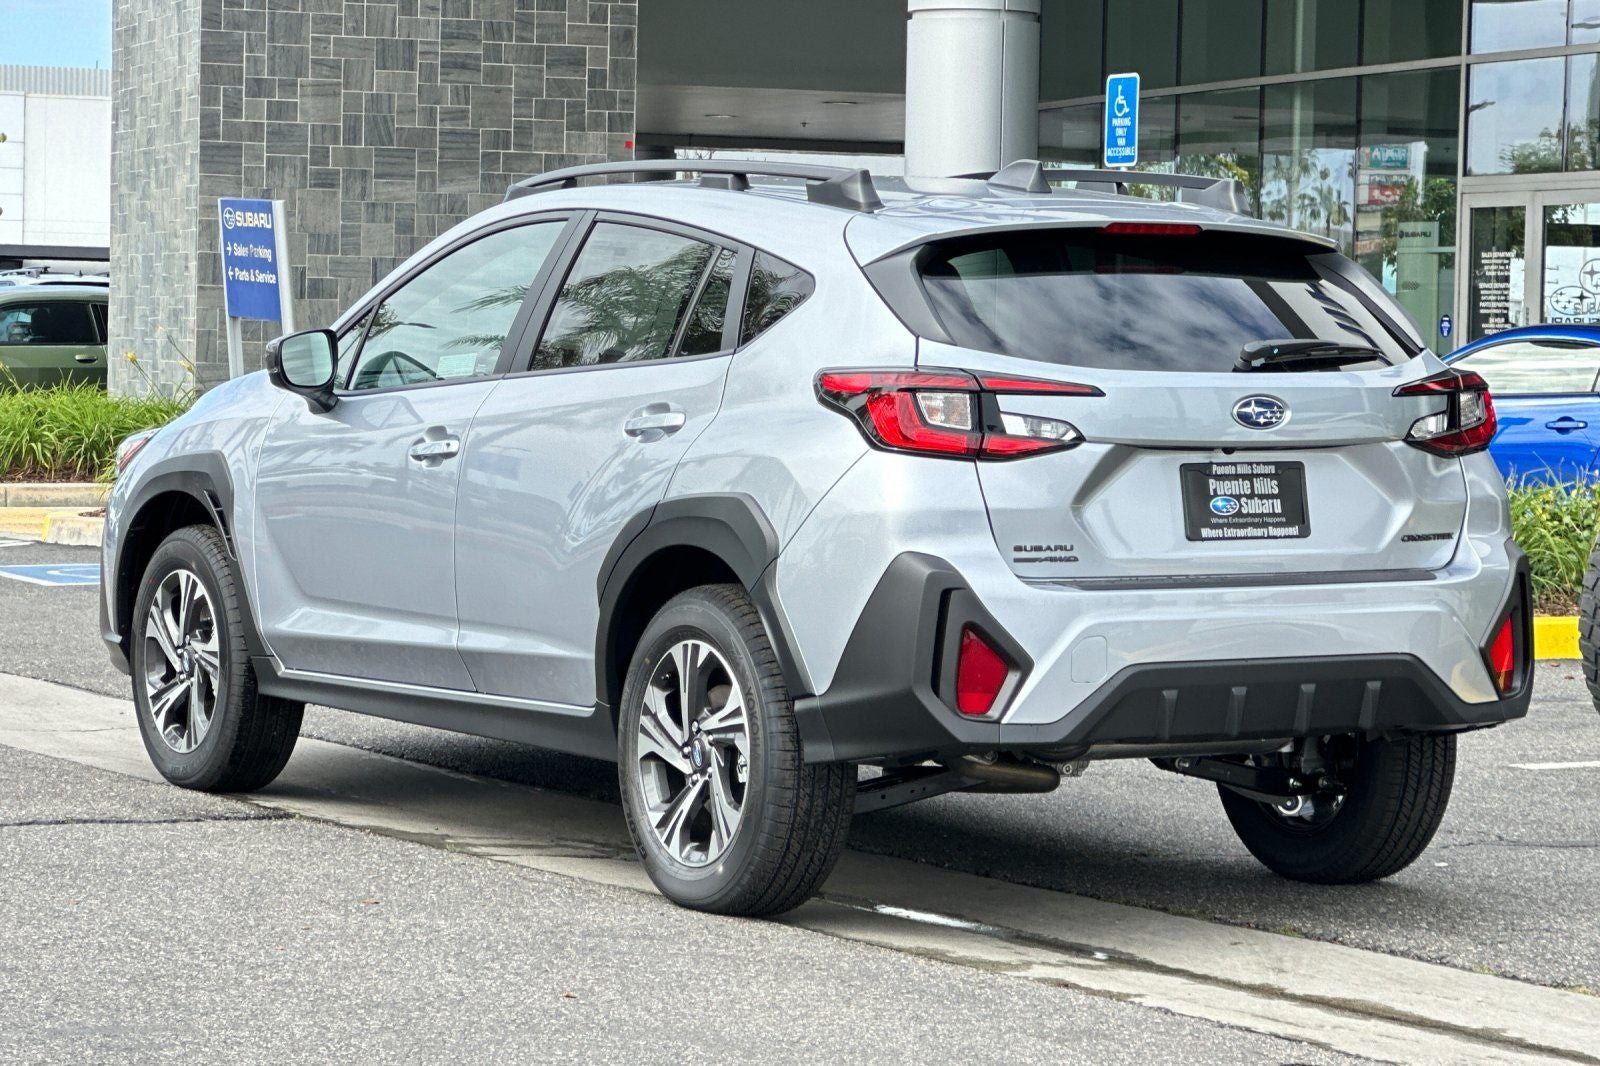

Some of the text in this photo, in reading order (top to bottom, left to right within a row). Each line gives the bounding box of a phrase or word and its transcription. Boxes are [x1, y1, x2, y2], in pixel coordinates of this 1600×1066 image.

[1112, 116, 1131, 127] PARKING
[1115, 127, 1127, 136] ONLY
[1117, 137, 1126, 146] VAN
[1107, 147, 1135, 156] ACCESSIBLE
[235, 211, 272, 229] SUBARU
[233, 243, 272, 262] Sales Parking
[234, 267, 277, 284] Parts & Service
[1212, 463, 1276, 475] Puente Hills Subaru
[1208, 477, 1279, 495] Puente Hills
[1240, 497, 1282, 514] Subaru
[1201, 525, 1299, 538] Where Extraordinary Happens!
[1013, 544, 1074, 552] SUBARU
